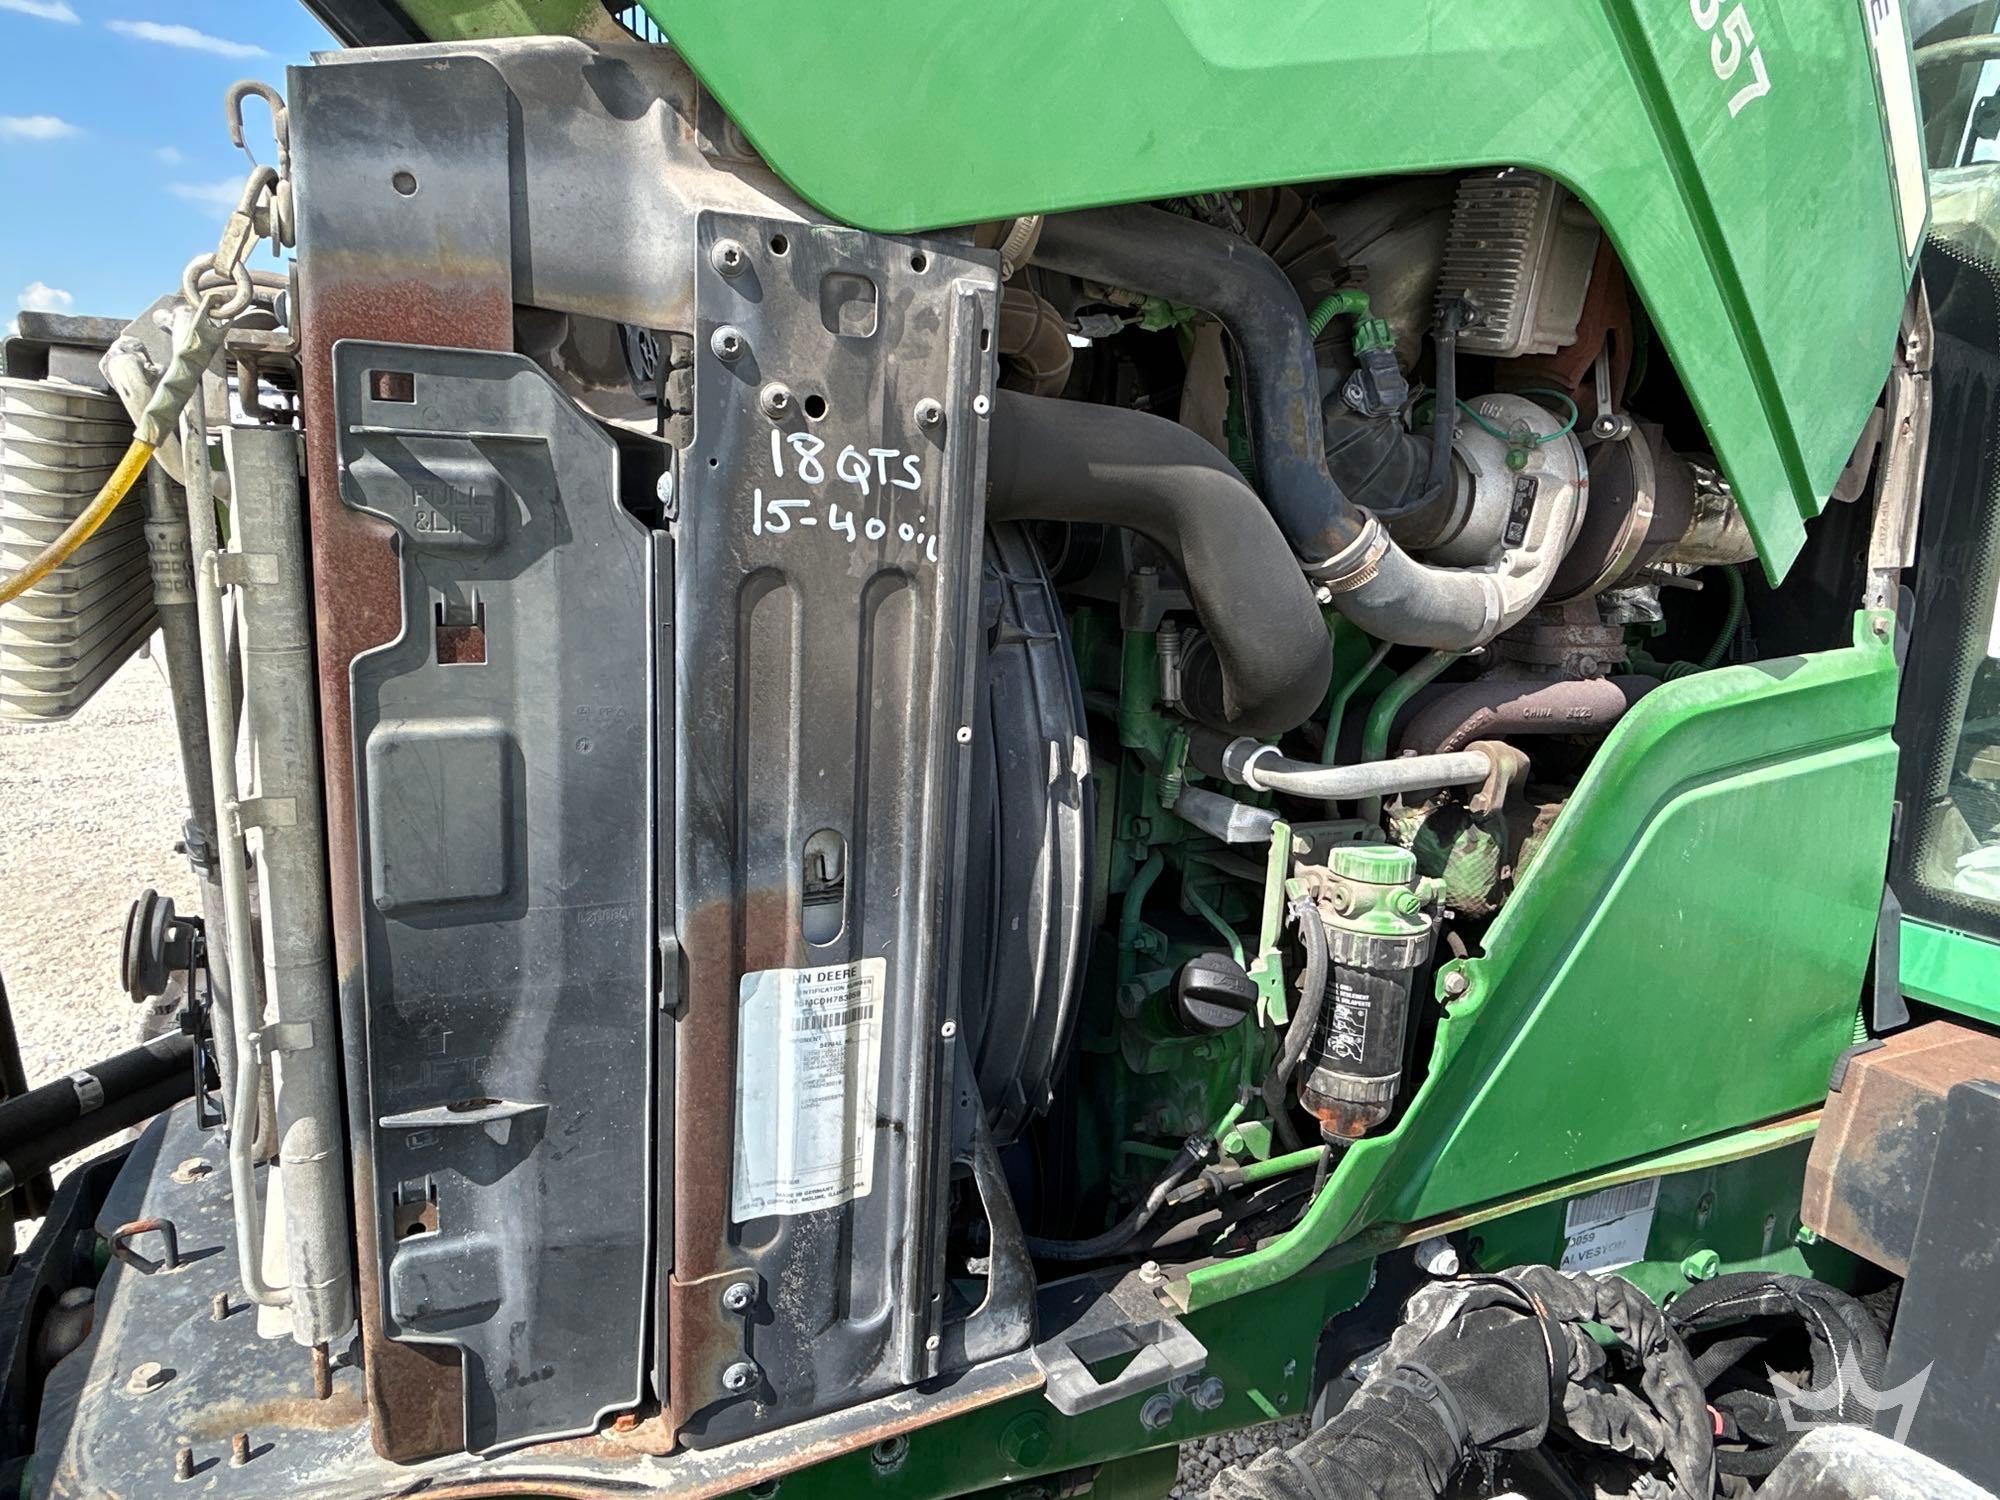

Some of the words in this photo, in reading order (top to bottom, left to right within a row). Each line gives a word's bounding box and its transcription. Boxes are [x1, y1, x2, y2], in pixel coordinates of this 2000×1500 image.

[836, 444, 921, 495] QTS
[817, 966, 857, 982] DEERE
[802, 985, 845, 995] NTIFICATION
